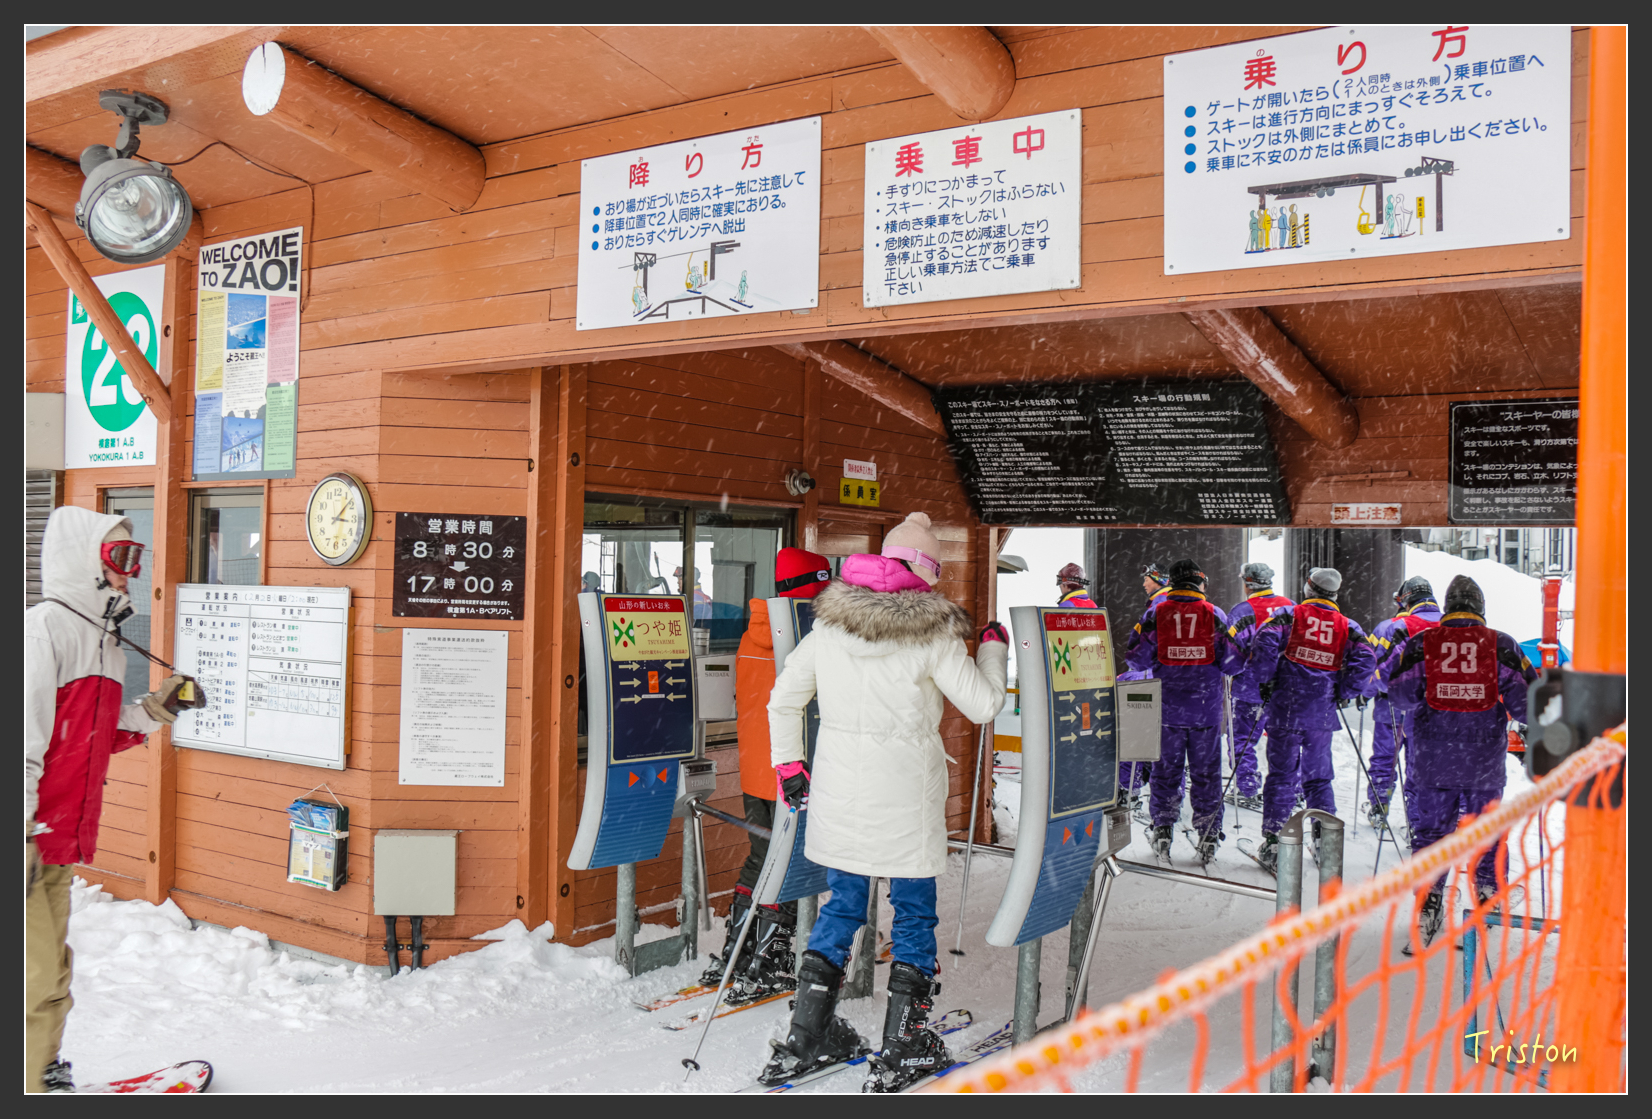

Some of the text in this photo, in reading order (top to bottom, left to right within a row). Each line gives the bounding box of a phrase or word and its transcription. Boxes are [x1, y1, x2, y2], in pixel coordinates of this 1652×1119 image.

[1244, 26, 1470, 90] 乗り方
[1344, 73, 1391, 88] 2人同時
[1344, 75, 1442, 98] 1人のときは外側
[895, 125, 1045, 177] 乗車中
[1206, 116, 1548, 172] 乗車に不安のかたは係員にお申し出ください。
[629, 143, 764, 189] 降り方
[605, 171, 806, 216] おり場が近づいたらスキー先に注意して
[604, 195, 787, 234] 降車位置で2人同時に確実におりる。
[604, 218, 746, 251] おりたらすぐゲレンデへ脱出
[202, 231, 299, 265] WELCOME
[885, 237, 1050, 266] 急停止することがあります
[201, 257, 298, 292] TO ZAO!
[885, 254, 1035, 282] 正しい乗車方法でご乗車
[885, 282, 923, 296] 下さい
[1133, 394, 1211, 403] スキー場の行動規則
[89, 453, 123, 462] YOKOKURA
[126, 452, 129, 461] 1
[334, 488, 342, 496] 12
[843, 484, 877, 501] 係員室
[320, 502, 327, 510] 10
[349, 501, 354, 510] 2
[1334, 507, 1399, 520] 頭上注意
[318, 514, 323, 523] 9
[351, 515, 357, 523] 3
[428, 519, 493, 535] 営業時間
[326, 538, 331, 546] 7
[333, 541, 338, 550] 6
[342, 539, 347, 547] 5
[619, 600, 671, 610] 山形の新しいお米
[637, 620, 682, 637] つや姫
[1056, 618, 1096, 627] 山形の新しいお米
[1173, 613, 1197, 639] 17
[1305, 616, 1334, 644] 25
[1071, 641, 1106, 661] つや姫
[1169, 647, 1205, 658] 福岡大学
[1298, 648, 1333, 664] 福岡大学
[1441, 642, 1478, 674] 23
[1439, 685, 1483, 698] 福岡大学
[898, 1004, 910, 1038] EDGE
[969, 1031, 1013, 1054] HEAD
[900, 1056, 935, 1067] HEAD
